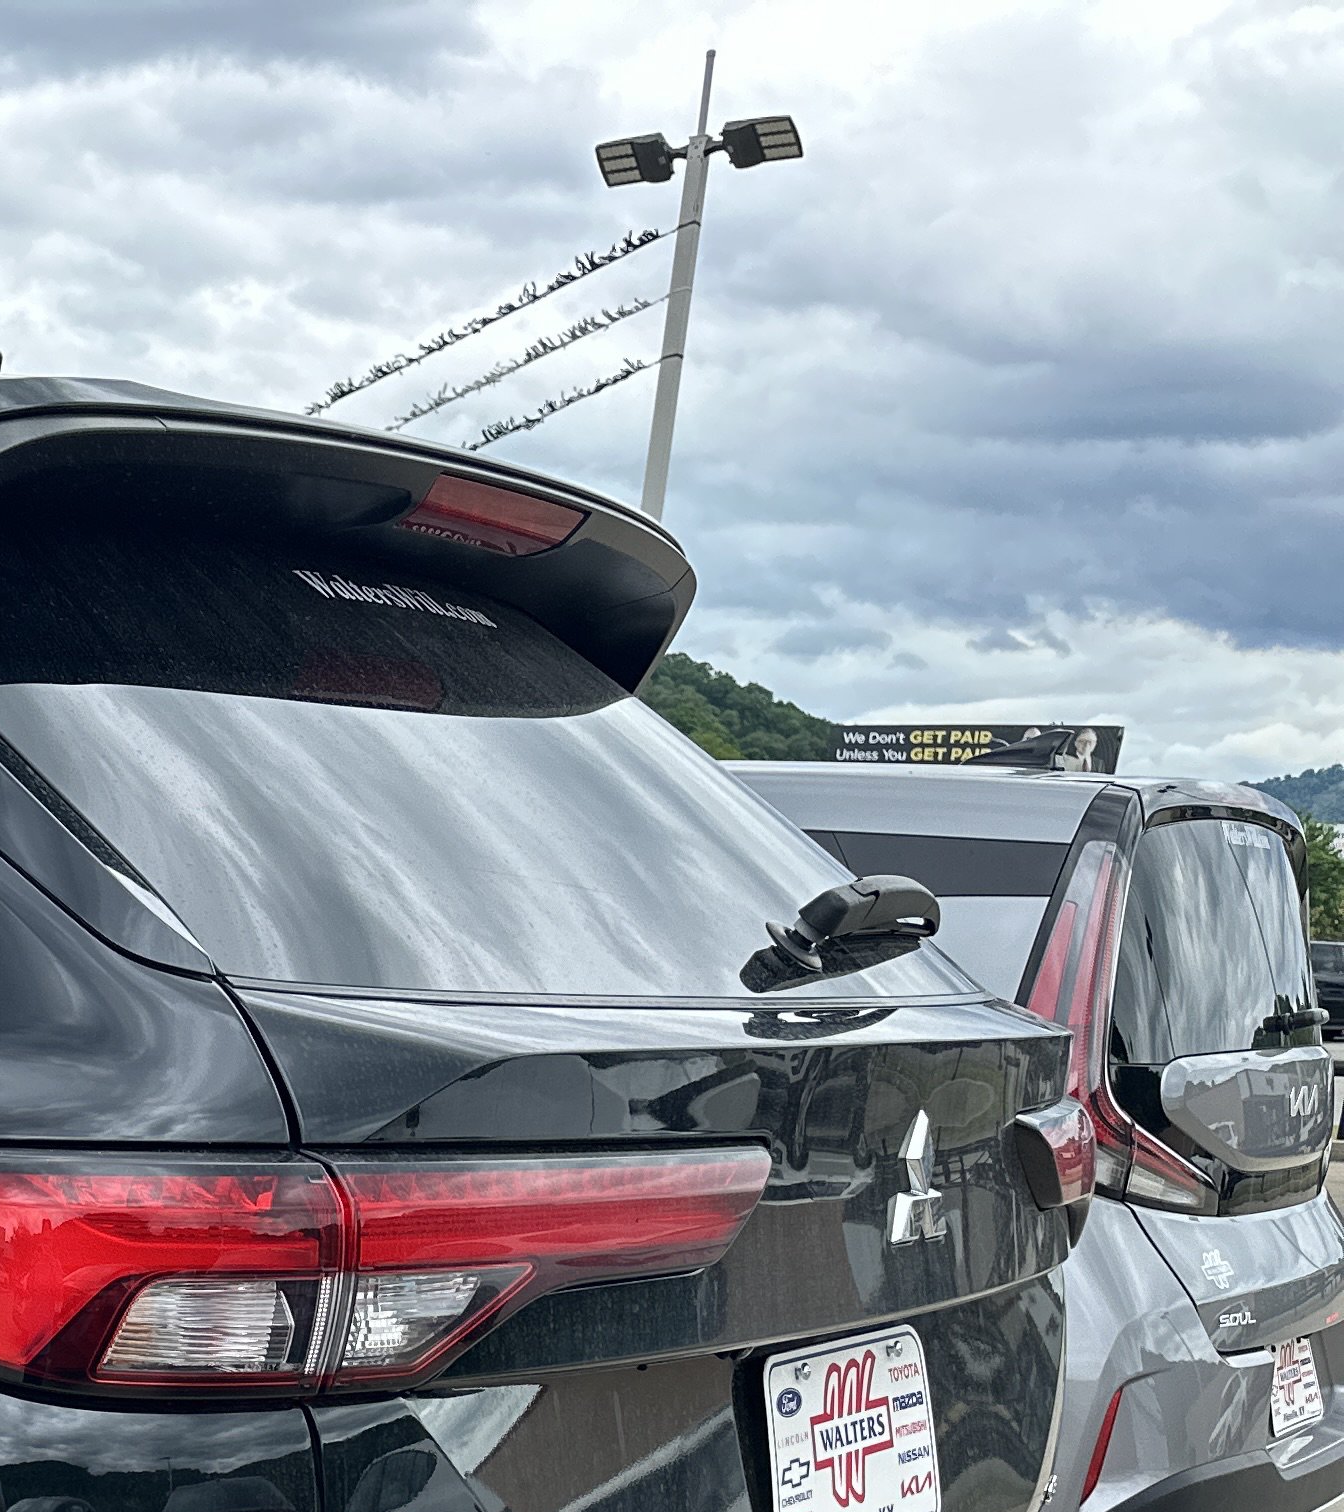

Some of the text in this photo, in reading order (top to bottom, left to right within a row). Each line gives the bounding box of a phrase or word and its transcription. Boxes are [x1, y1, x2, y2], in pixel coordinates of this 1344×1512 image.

[843, 729, 993, 745] We Don't GET PAID
[836, 748, 879, 762] Unless
[882, 748, 907, 761] You
[909, 747, 947, 762] GET
[1219, 1311, 1256, 1328] SOUL
[888, 1363, 920, 1383] TOYOTA
[781, 1393, 798, 1413] Ford
[777, 1431, 809, 1449] LINCOLN
[820, 1414, 885, 1452] WALTERS
[898, 1445, 930, 1465] NISSAN
